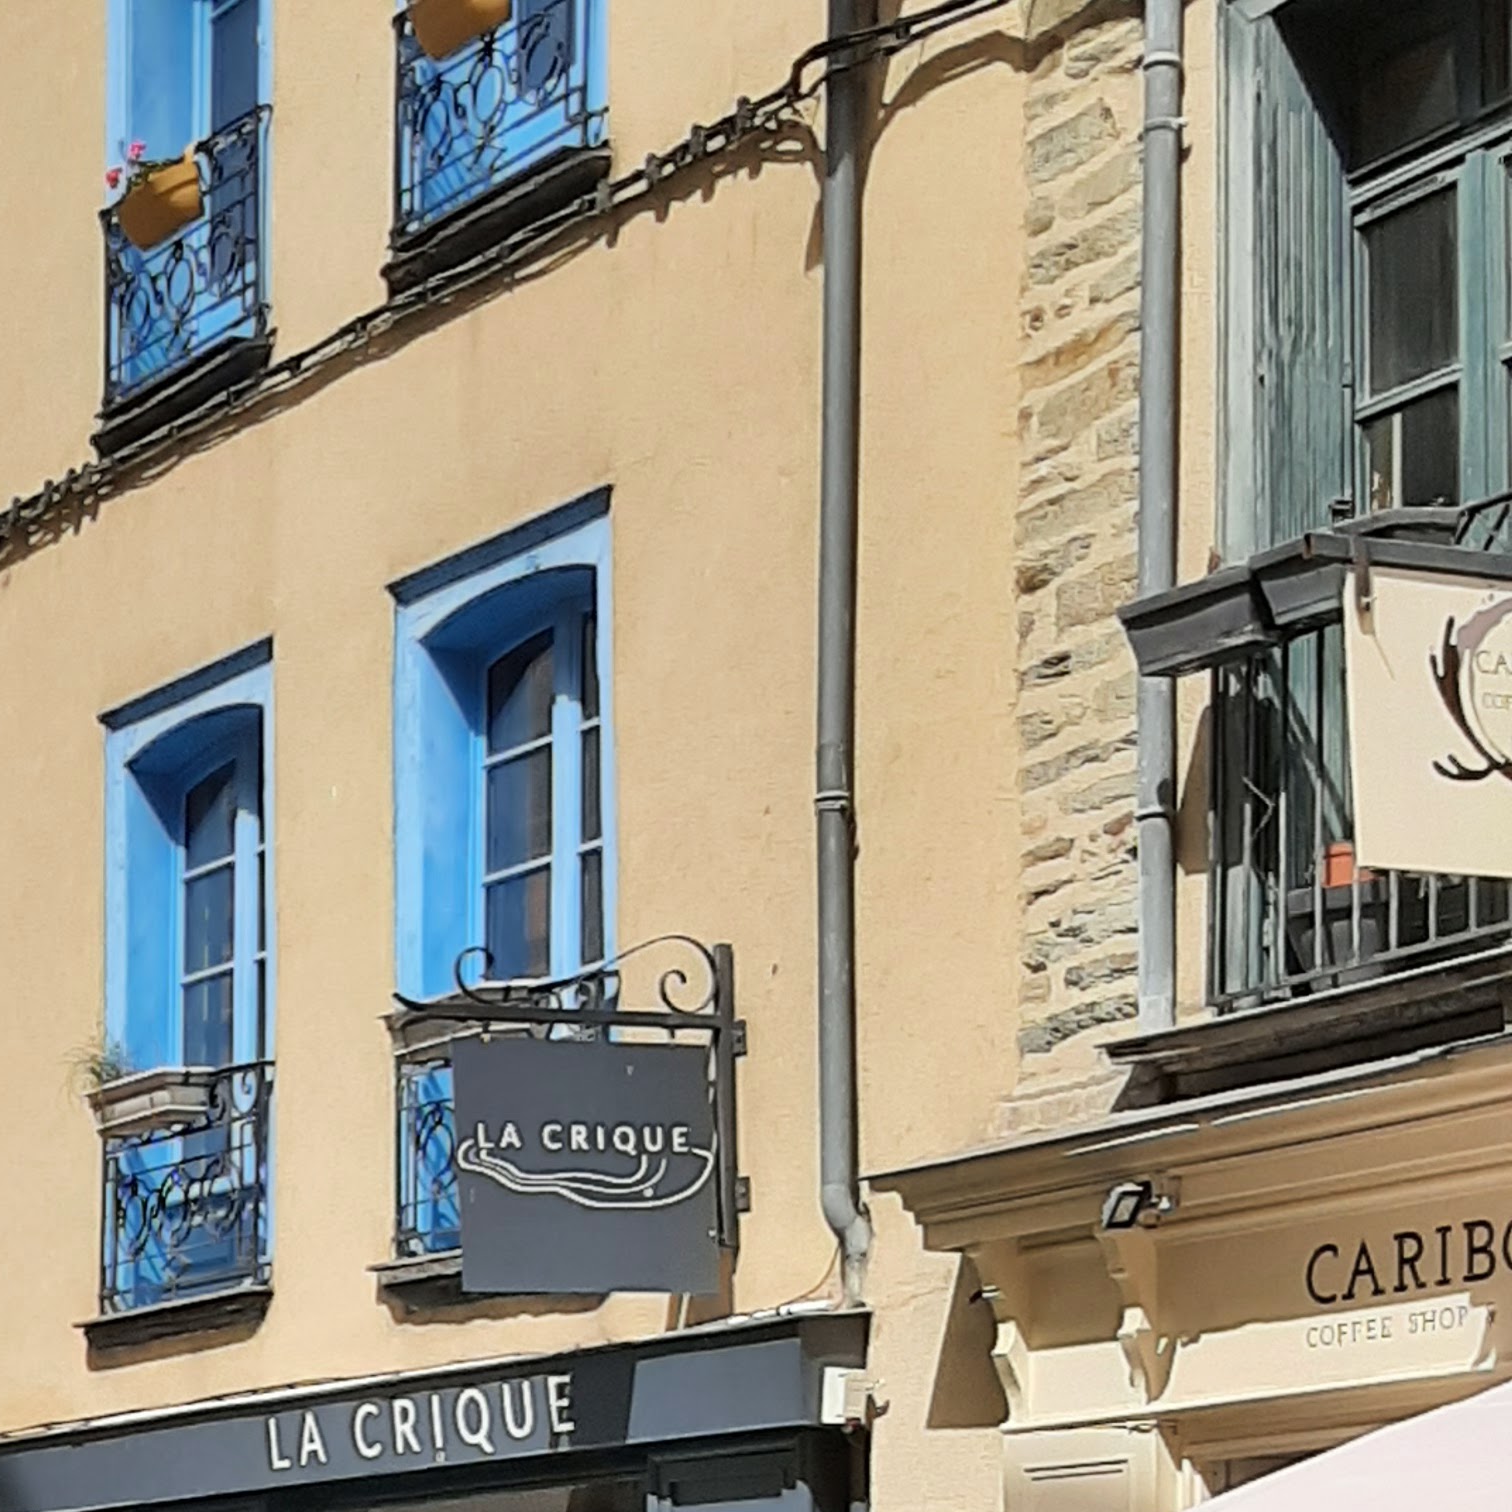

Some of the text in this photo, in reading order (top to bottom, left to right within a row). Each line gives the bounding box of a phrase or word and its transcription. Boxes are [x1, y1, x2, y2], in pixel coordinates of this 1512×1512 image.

[476, 1121, 692, 1157] LA CRIQUE
[1305, 1305, 1469, 1348] COFFEE SHOP
[266, 1373, 575, 1471] LA CRIQUE
